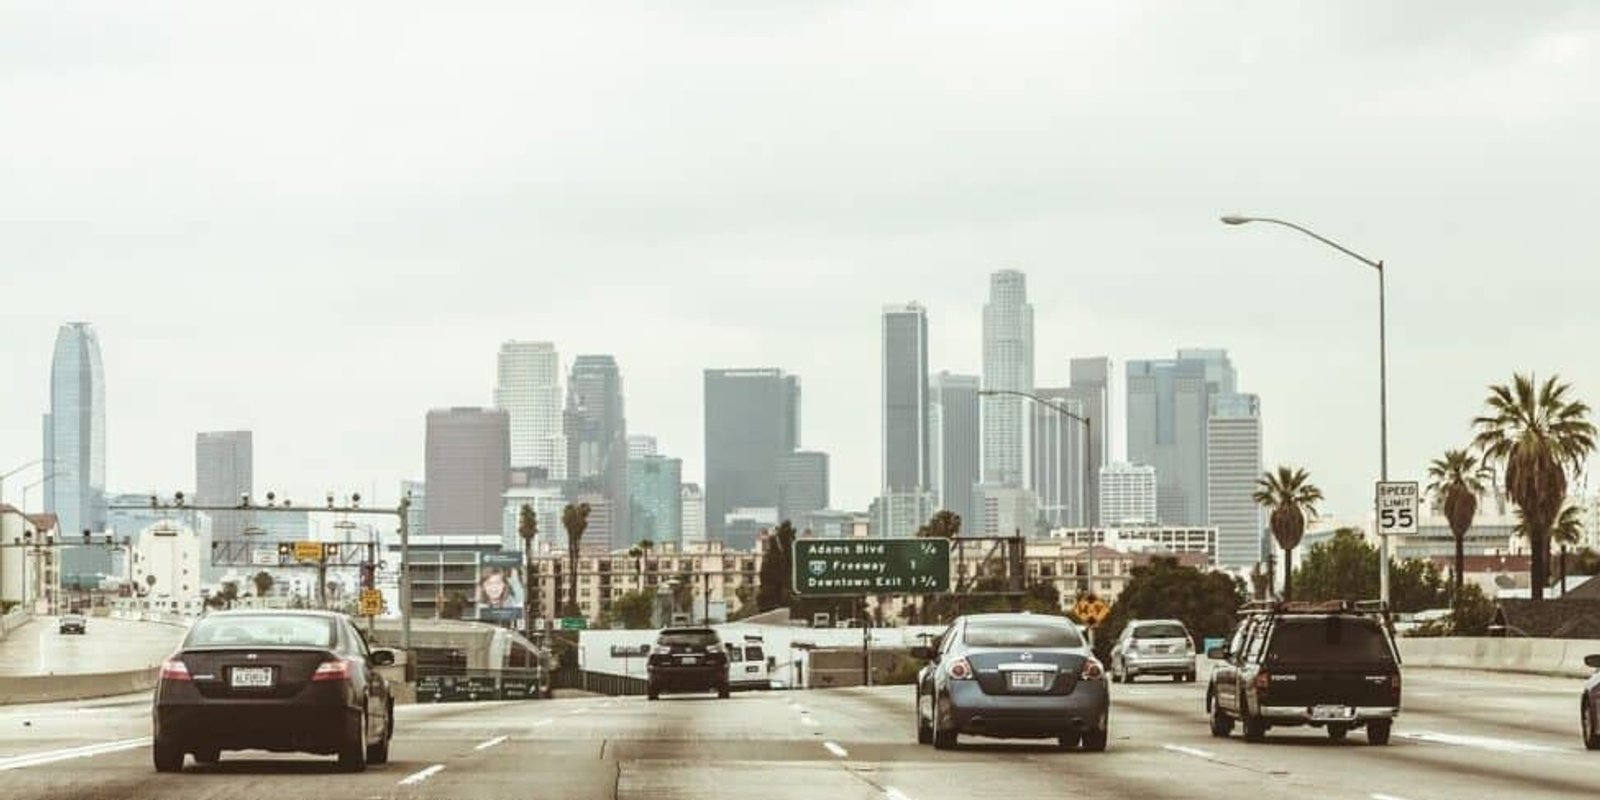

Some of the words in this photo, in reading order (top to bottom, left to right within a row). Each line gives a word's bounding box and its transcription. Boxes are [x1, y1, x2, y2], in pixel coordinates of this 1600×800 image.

[1381, 486, 1415, 496] SPEED
[1383, 498, 1410, 507] LIMIT
[1381, 509, 1413, 528] 55
[808, 544, 850, 554] Adams
[855, 544, 885, 554] Blvd
[833, 560, 886, 573] Freeway
[910, 559, 916, 570] 1
[808, 577, 870, 587] Downtown
[876, 577, 902, 587] Exit
[911, 577, 916, 586] 1
